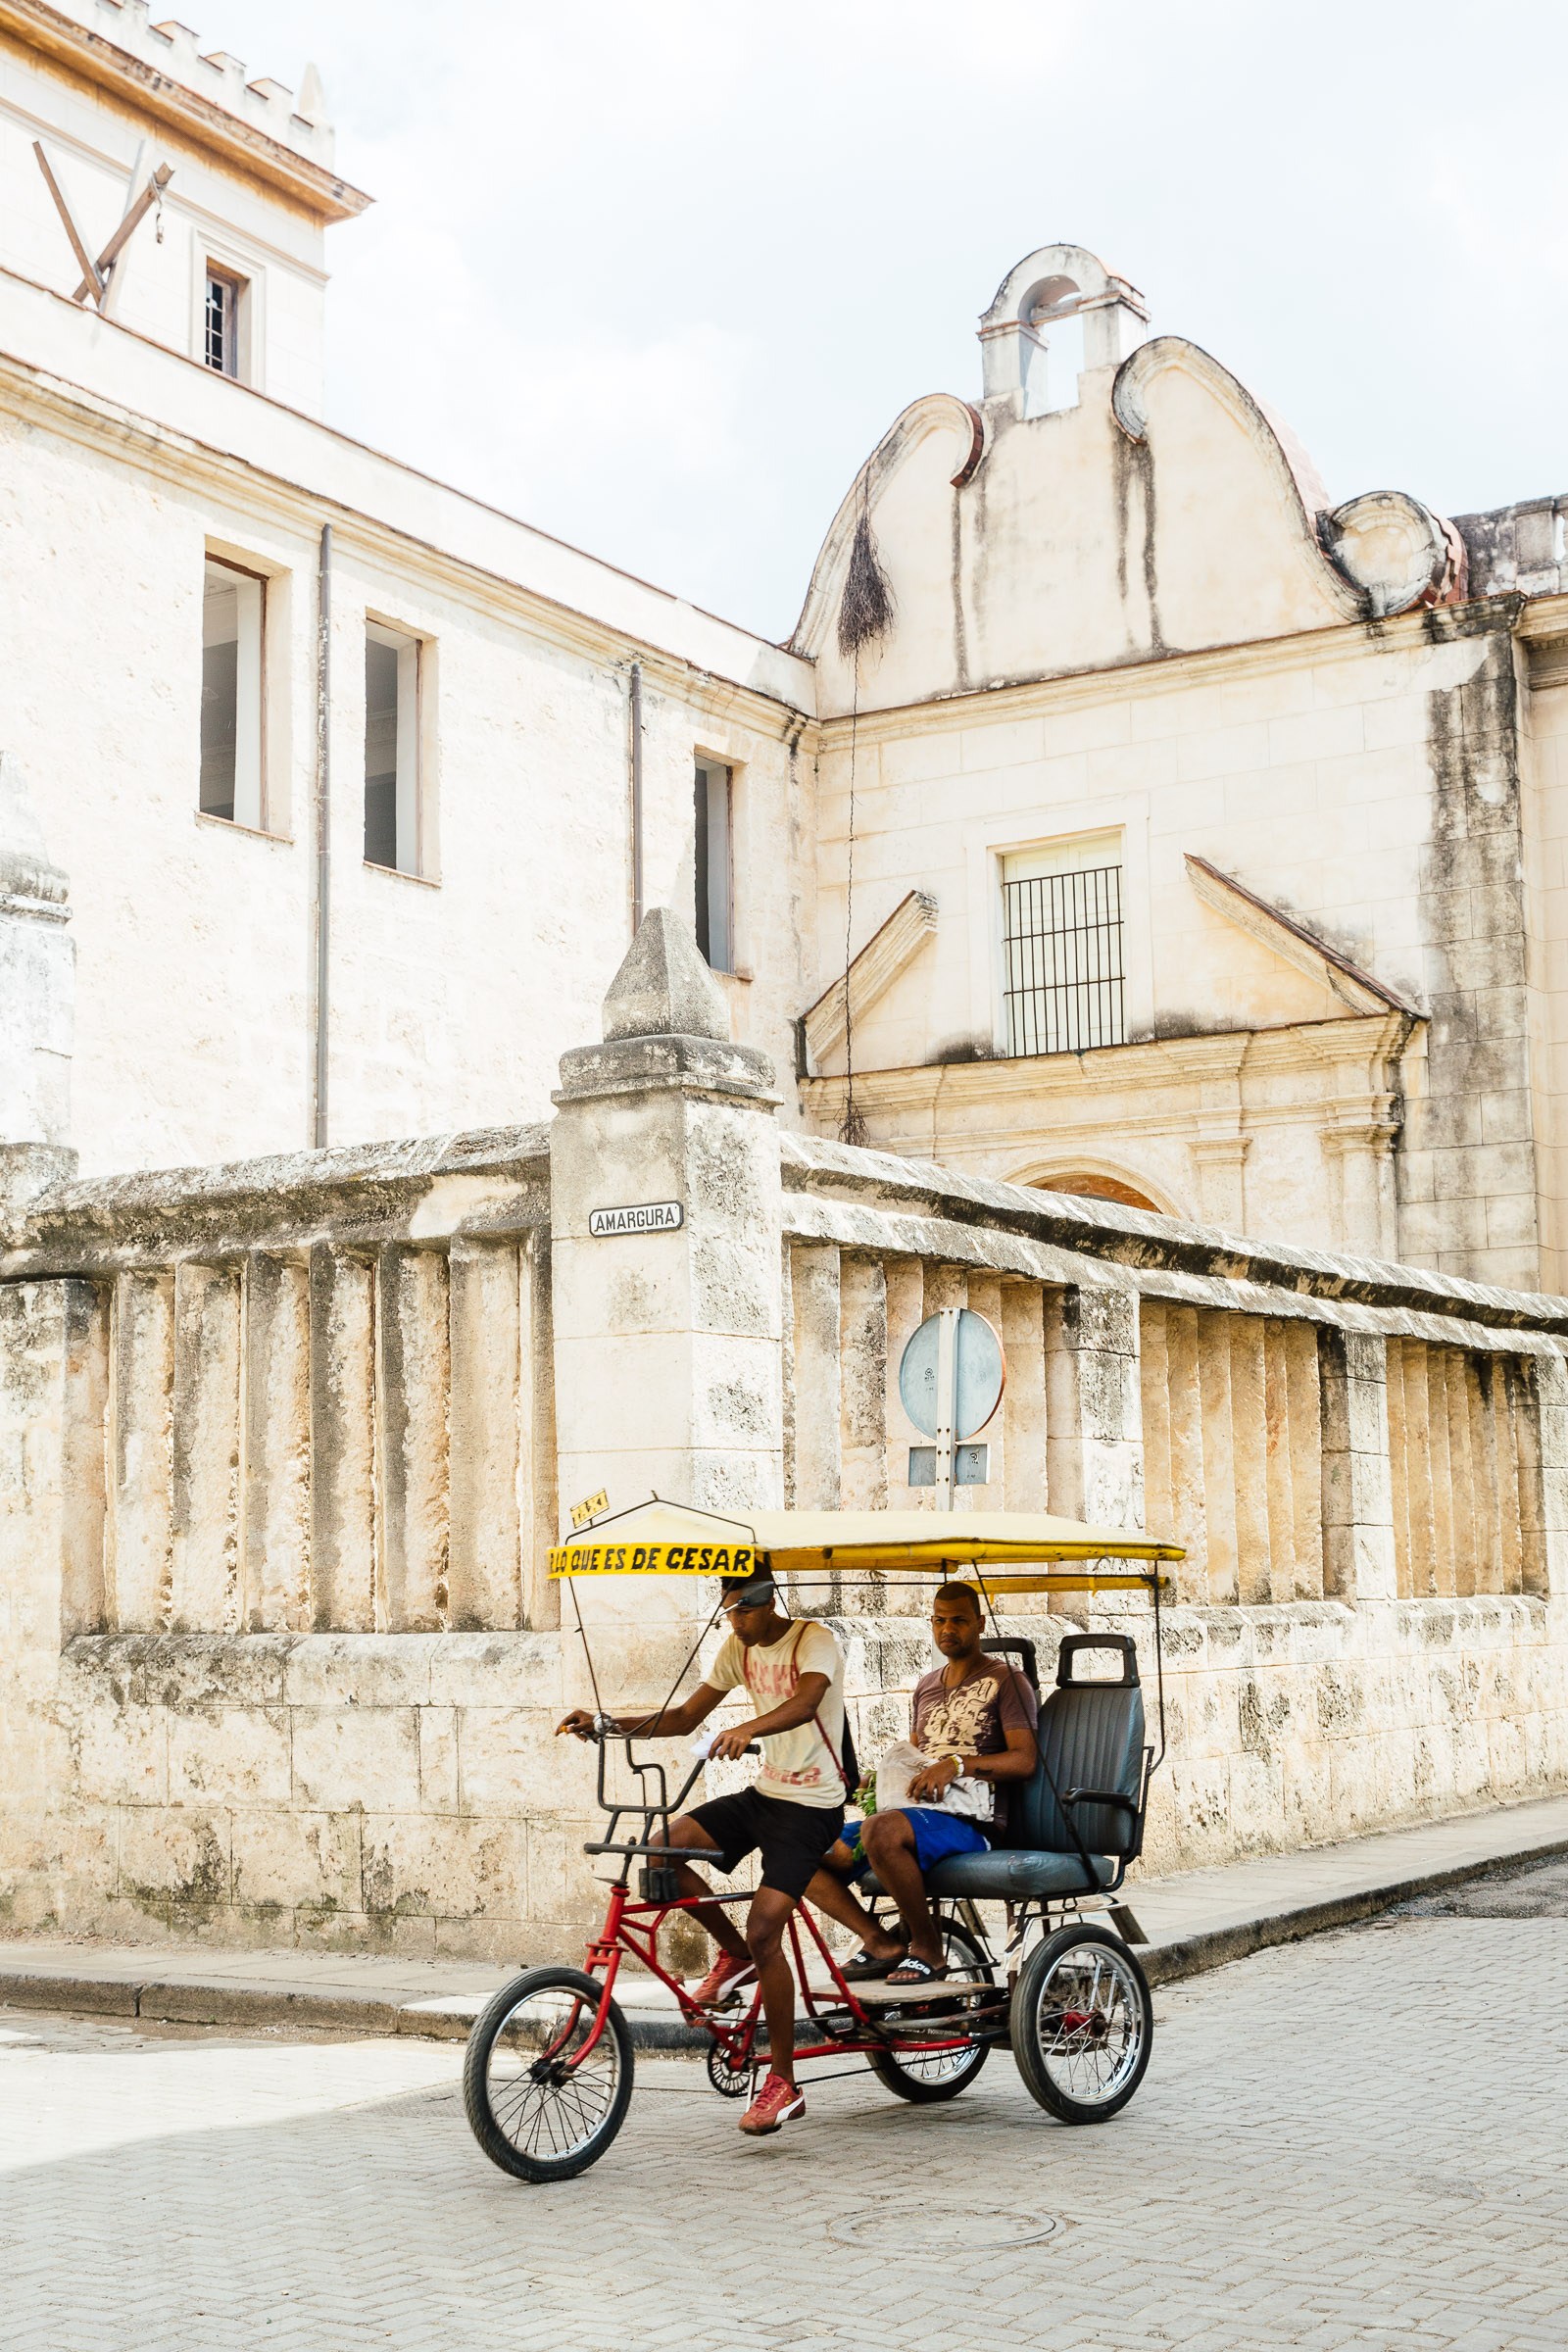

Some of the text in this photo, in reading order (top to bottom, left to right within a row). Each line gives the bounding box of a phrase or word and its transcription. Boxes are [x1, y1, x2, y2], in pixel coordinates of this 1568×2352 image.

[594, 1206, 675, 1232] AMARGURA
[571, 1548, 601, 1571] QUE
[604, 1548, 626, 1570] ES
[630, 1547, 662, 1570] DE
[665, 1547, 752, 1573] CESAR
